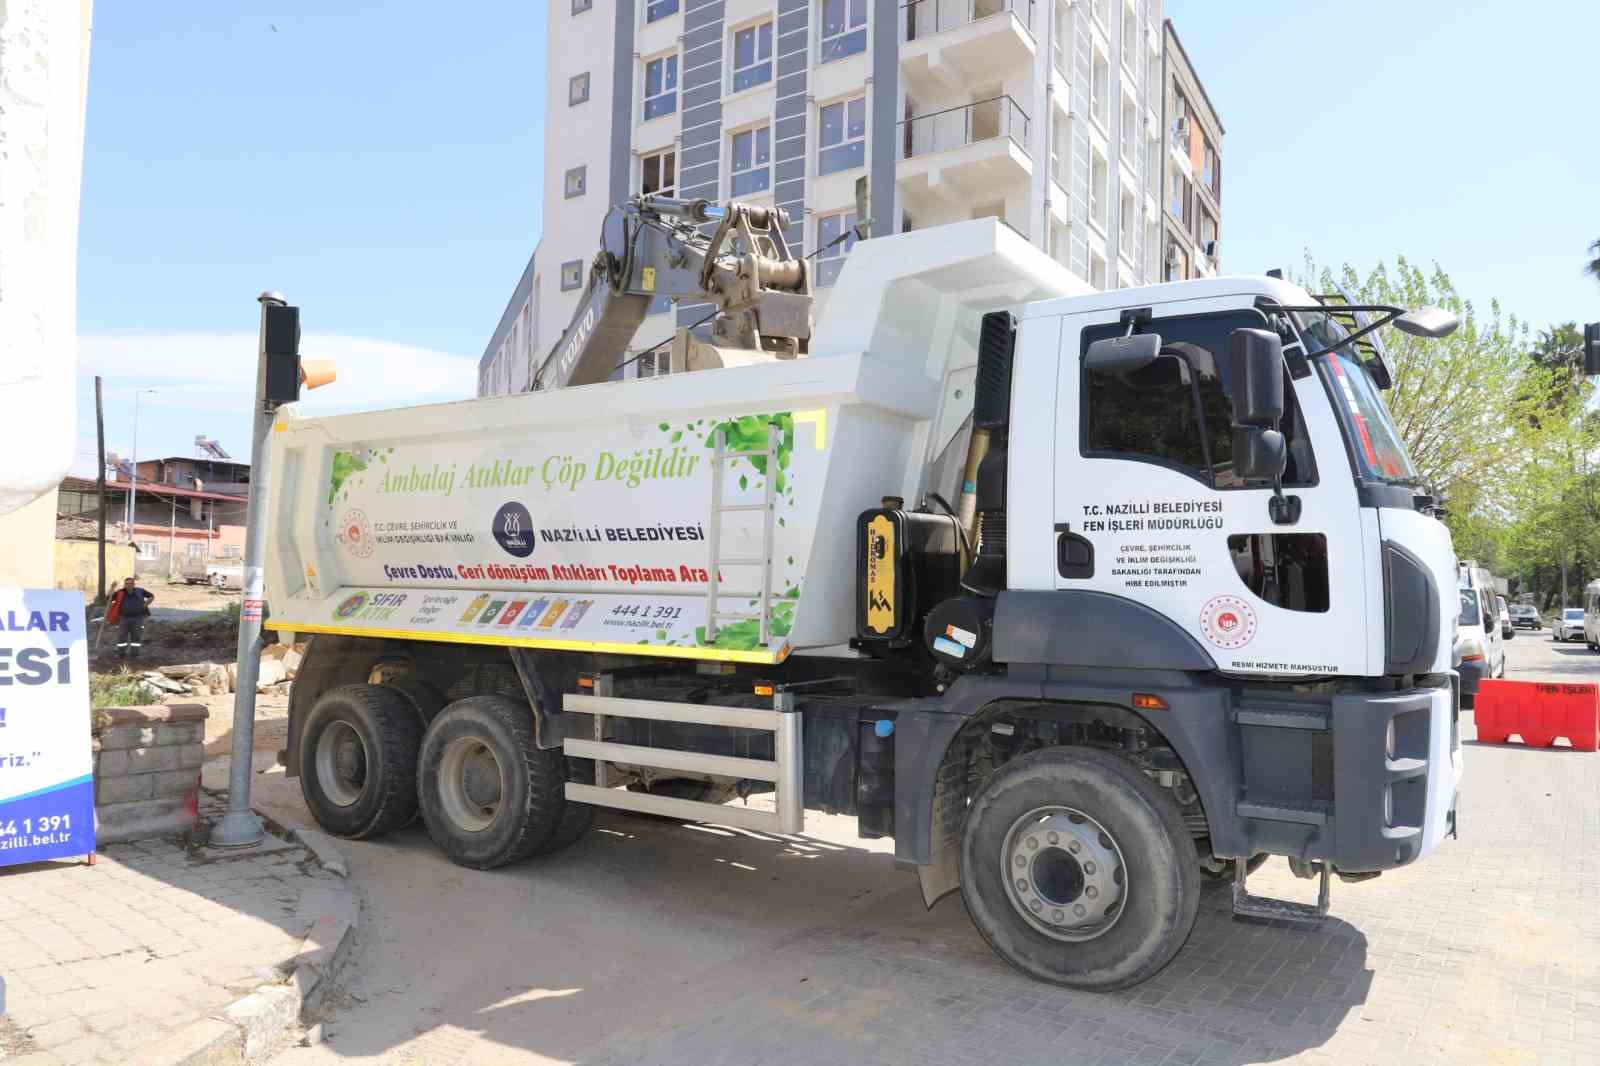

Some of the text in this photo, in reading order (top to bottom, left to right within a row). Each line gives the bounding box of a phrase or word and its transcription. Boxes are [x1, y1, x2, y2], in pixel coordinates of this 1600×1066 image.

[561, 307, 594, 375] VOLVO
[376, 446, 700, 496] Ambalaj Atıklar Çöp Değildir
[1083, 498, 1222, 515] T.C. NAZİLLİ BELEDİYESİ
[607, 522, 705, 542] BELEDİYESİ
[1083, 516, 1223, 533] FEN İŞLERİ MÜDÜRLÜĞÜ
[1116, 556, 1125, 564] VE
[384, 563, 723, 584] Çevre Dostu, Geri dönüşüm Atıkları Toplama Araı
[1154, 567, 1201, 576] TARAFINDAN
[369, 593, 407, 606] SIFIR
[612, 604, 682, 619] 444 1 391
[0, 610, 70, 632] LAR
[24, 818, 32, 834] 1
[38, 814, 71, 832] 391
